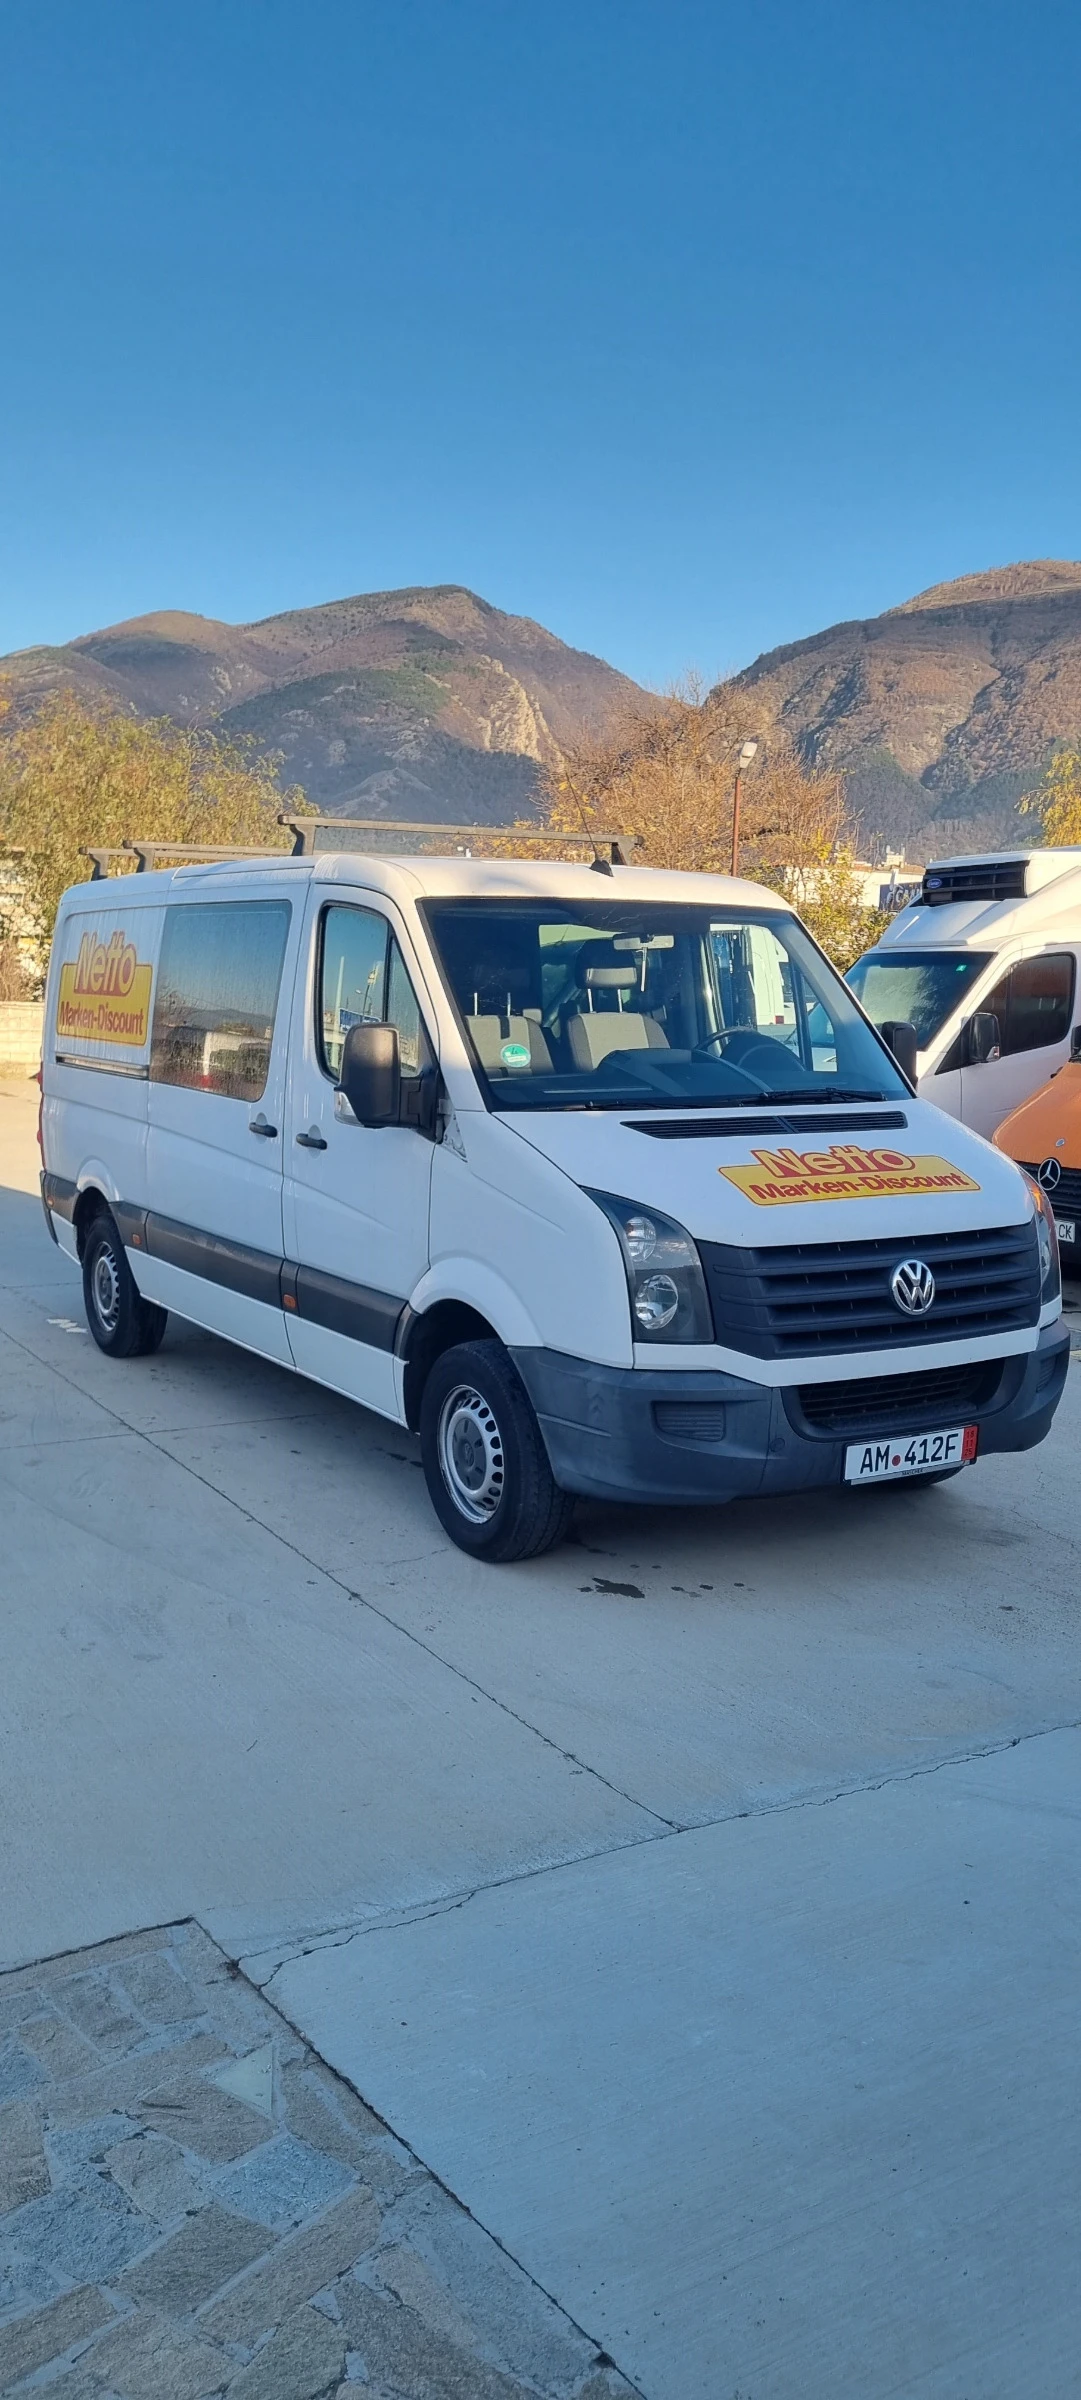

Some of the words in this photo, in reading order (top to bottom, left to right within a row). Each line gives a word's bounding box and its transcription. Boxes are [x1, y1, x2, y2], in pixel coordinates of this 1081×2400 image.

[74, 931, 136, 996] Netto
[60, 1001, 144, 1036] Marken-Discount
[751, 1145, 915, 1178] Netto
[749, 1173, 969, 1200] Marken-Discount
[860, 1445, 890, 1474] AM
[904, 1433, 959, 1466] 412F
